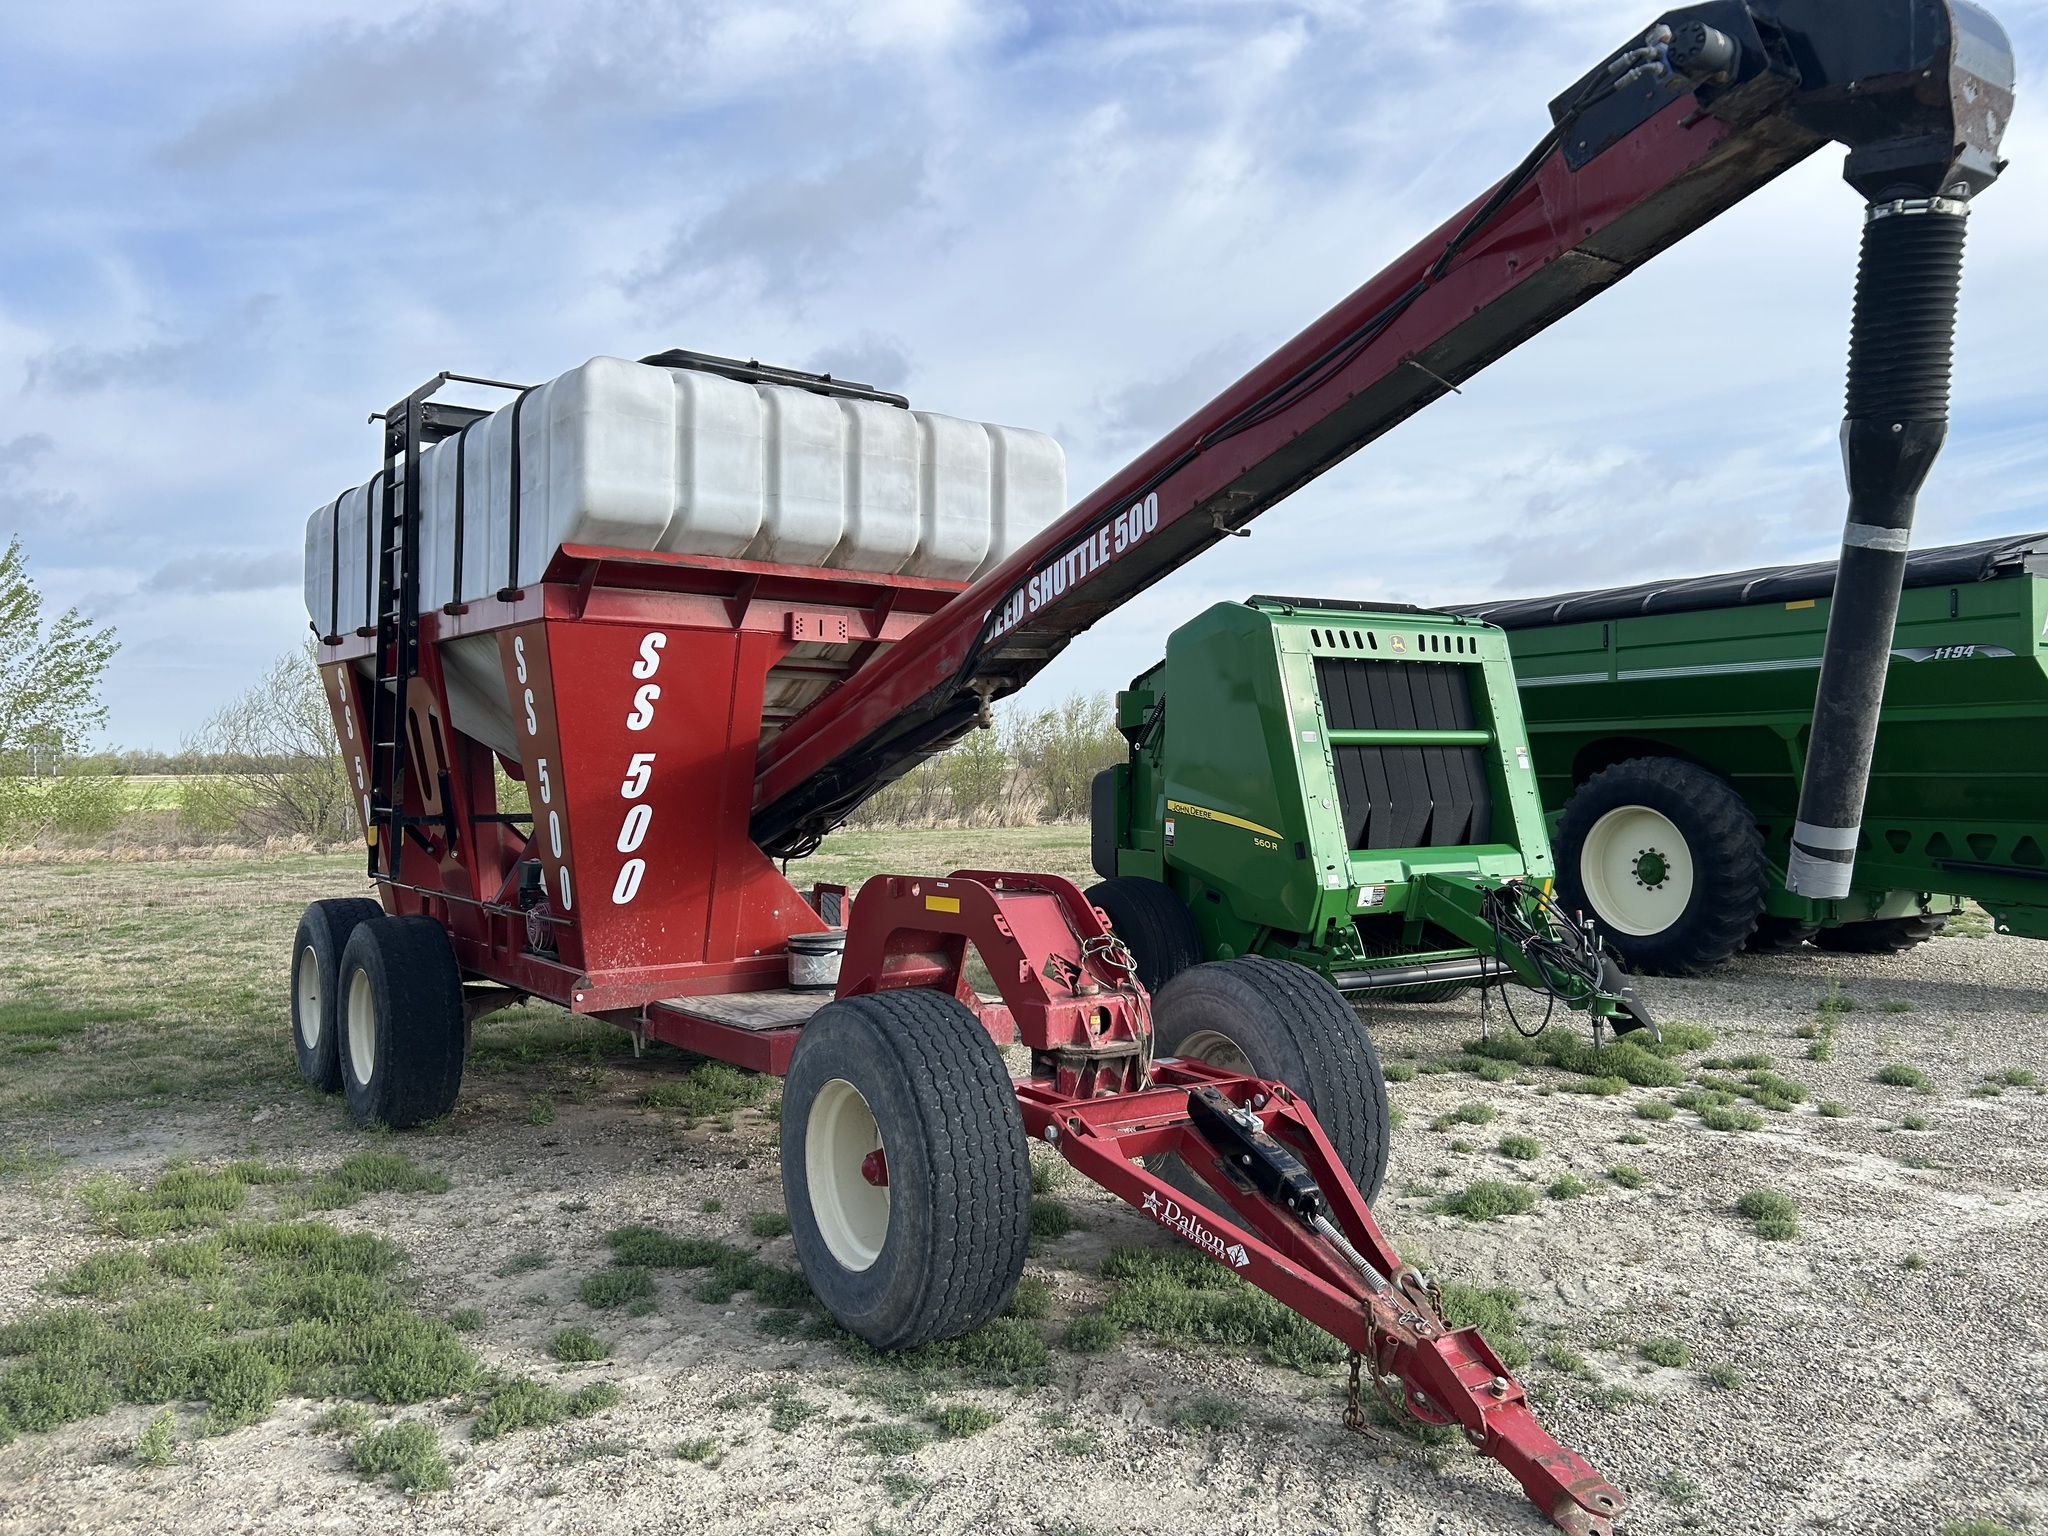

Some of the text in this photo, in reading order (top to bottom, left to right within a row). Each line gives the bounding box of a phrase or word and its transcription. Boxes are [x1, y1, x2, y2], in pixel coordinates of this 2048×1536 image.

[1028, 524, 1110, 613] SHUTTLE
[1114, 491, 1158, 554] 500
[1933, 645, 1975, 660] 1194
[537, 758, 572, 910] 500
[612, 753, 656, 905] 500
[1172, 803, 1212, 819] JOHN DEERE
[1253, 837, 1278, 851] 560 R
[1160, 1216, 1226, 1260] AG PRODUCTS
[1164, 1199, 1226, 1253] Dalton
